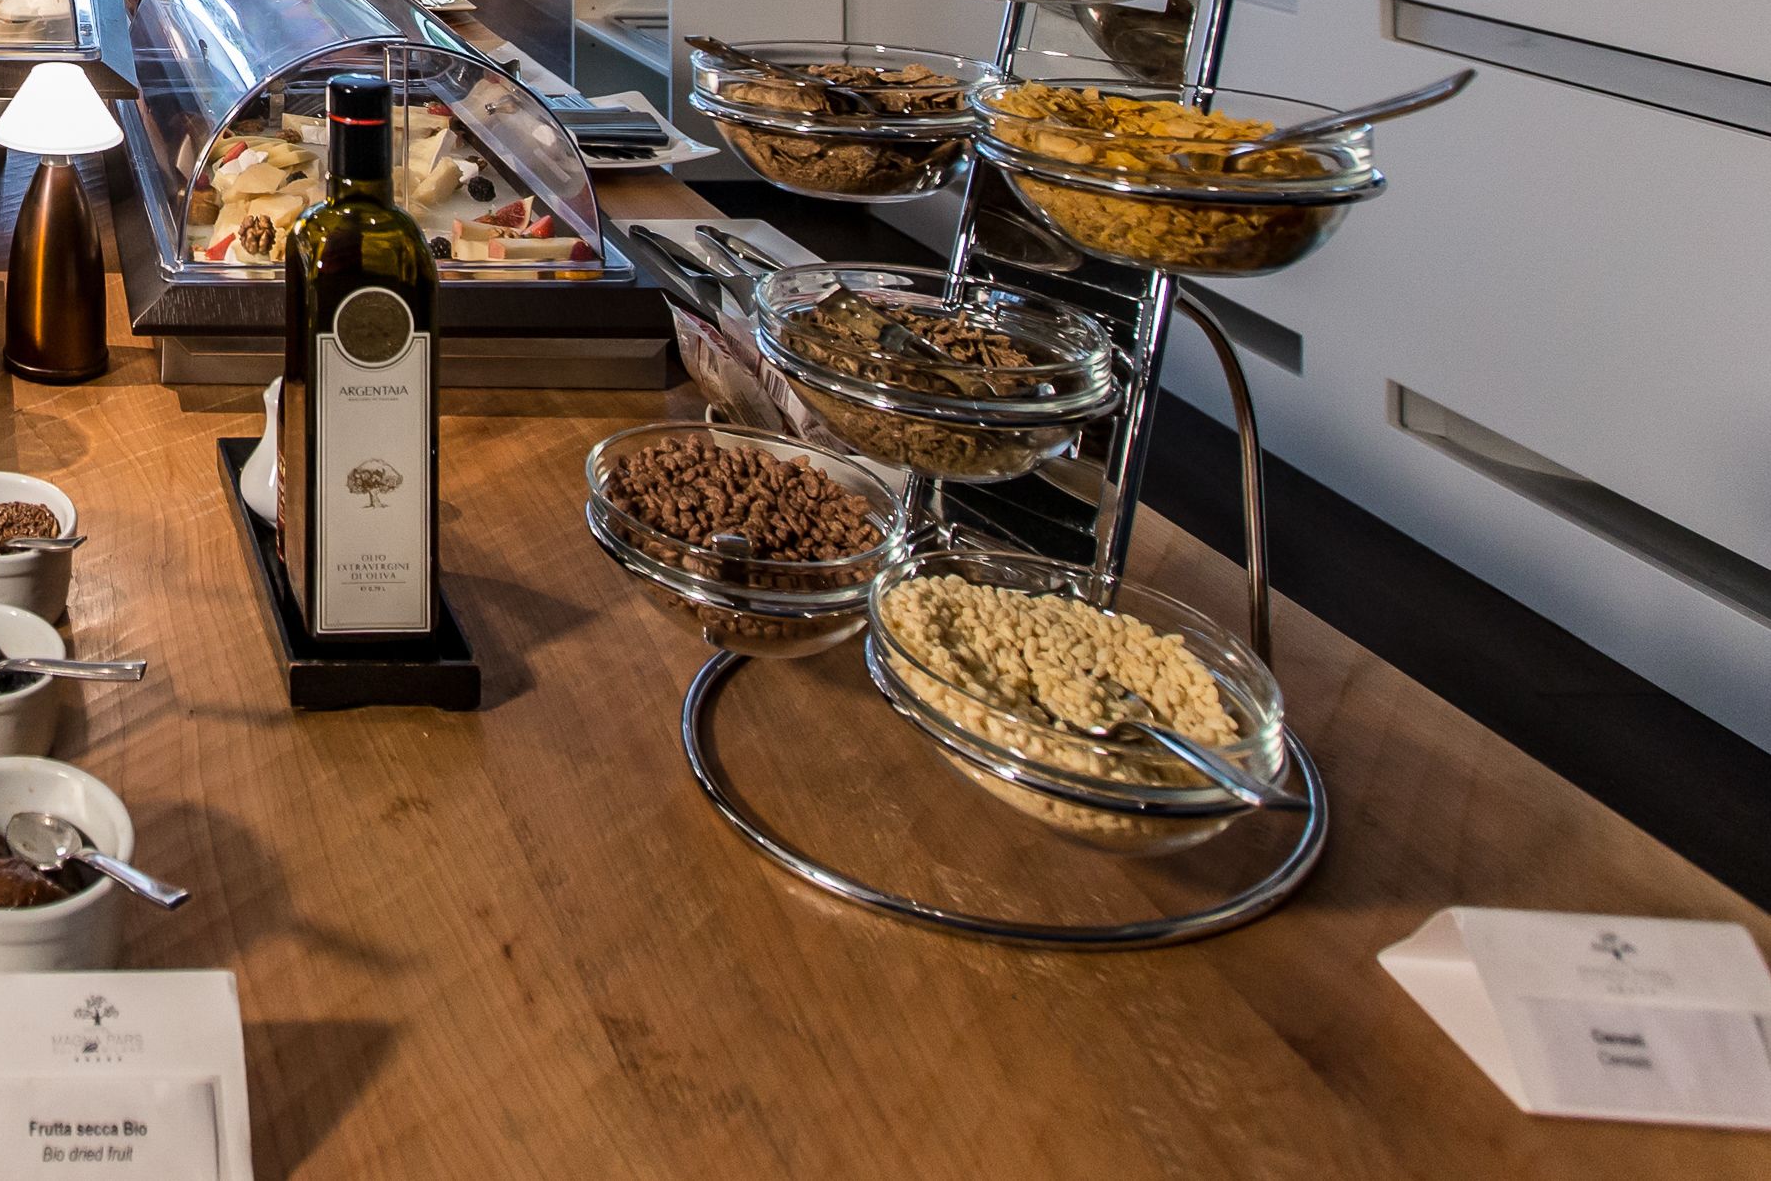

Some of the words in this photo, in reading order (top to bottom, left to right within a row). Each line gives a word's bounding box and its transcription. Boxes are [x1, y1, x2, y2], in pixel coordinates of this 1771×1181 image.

[339, 385, 409, 396] ARGENTAIA
[361, 554, 387, 562] OLIO
[337, 563, 410, 572] EXTRAVERGINE
[351, 572, 362, 580] DI
[366, 571, 396, 580] OLIVA
[29, 1120, 71, 1136] Frutta
[76, 1123, 119, 1136] secca
[123, 1121, 148, 1136] Bio
[42, 1146, 65, 1162] Bio
[68, 1146, 104, 1162] dried
[107, 1146, 133, 1162] fruit
